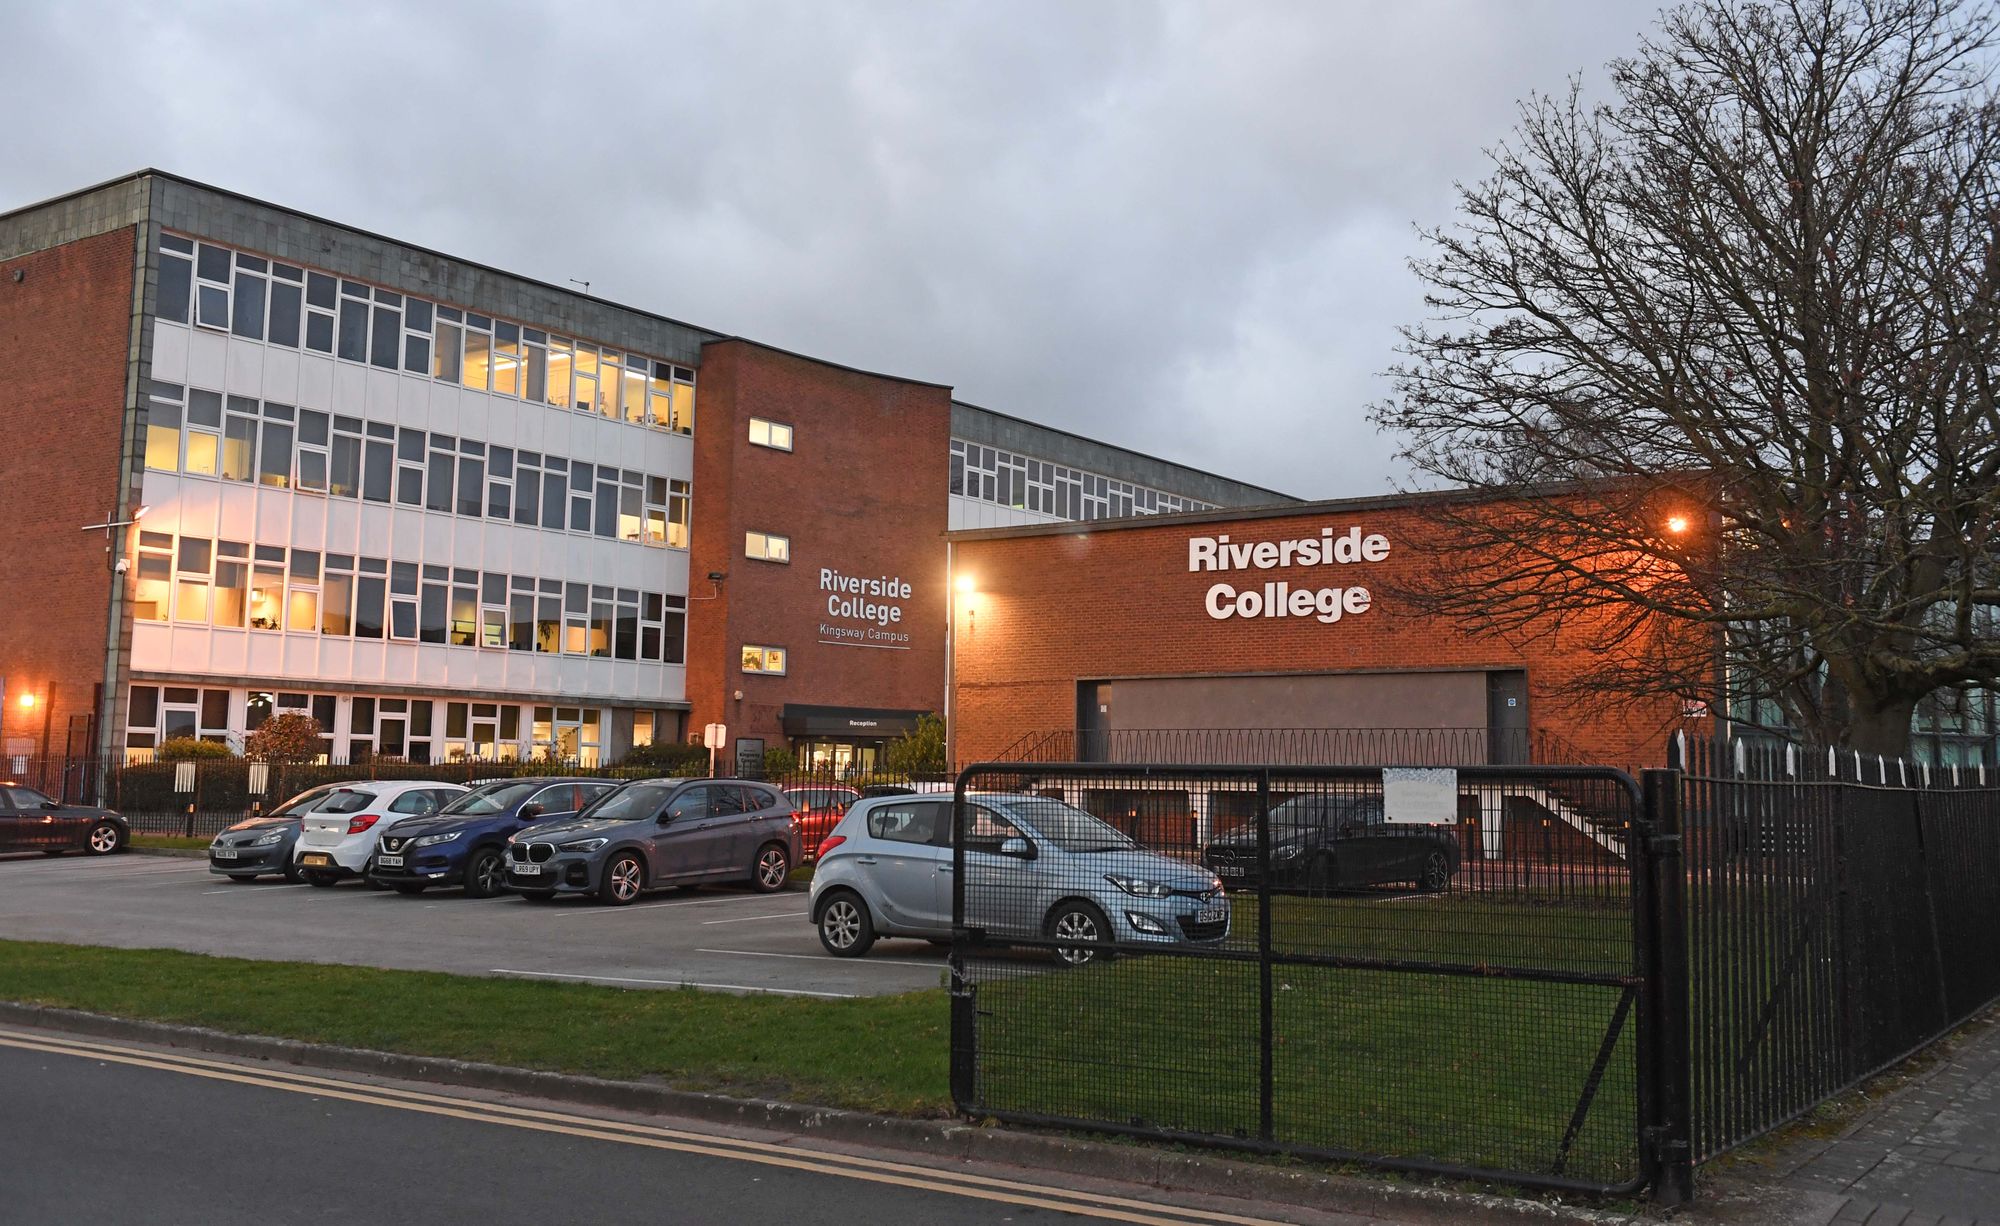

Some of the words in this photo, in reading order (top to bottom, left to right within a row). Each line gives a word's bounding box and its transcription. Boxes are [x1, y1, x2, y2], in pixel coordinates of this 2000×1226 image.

[1189, 526, 1391, 572] Riverside
[820, 568, 912, 599] Riverside
[828, 594, 901, 626] College
[1205, 581, 1371, 624] College
[820, 623, 865, 640] Kingsway
[868, 628, 909, 643] Campus
[849, 719, 878, 727] Reception
